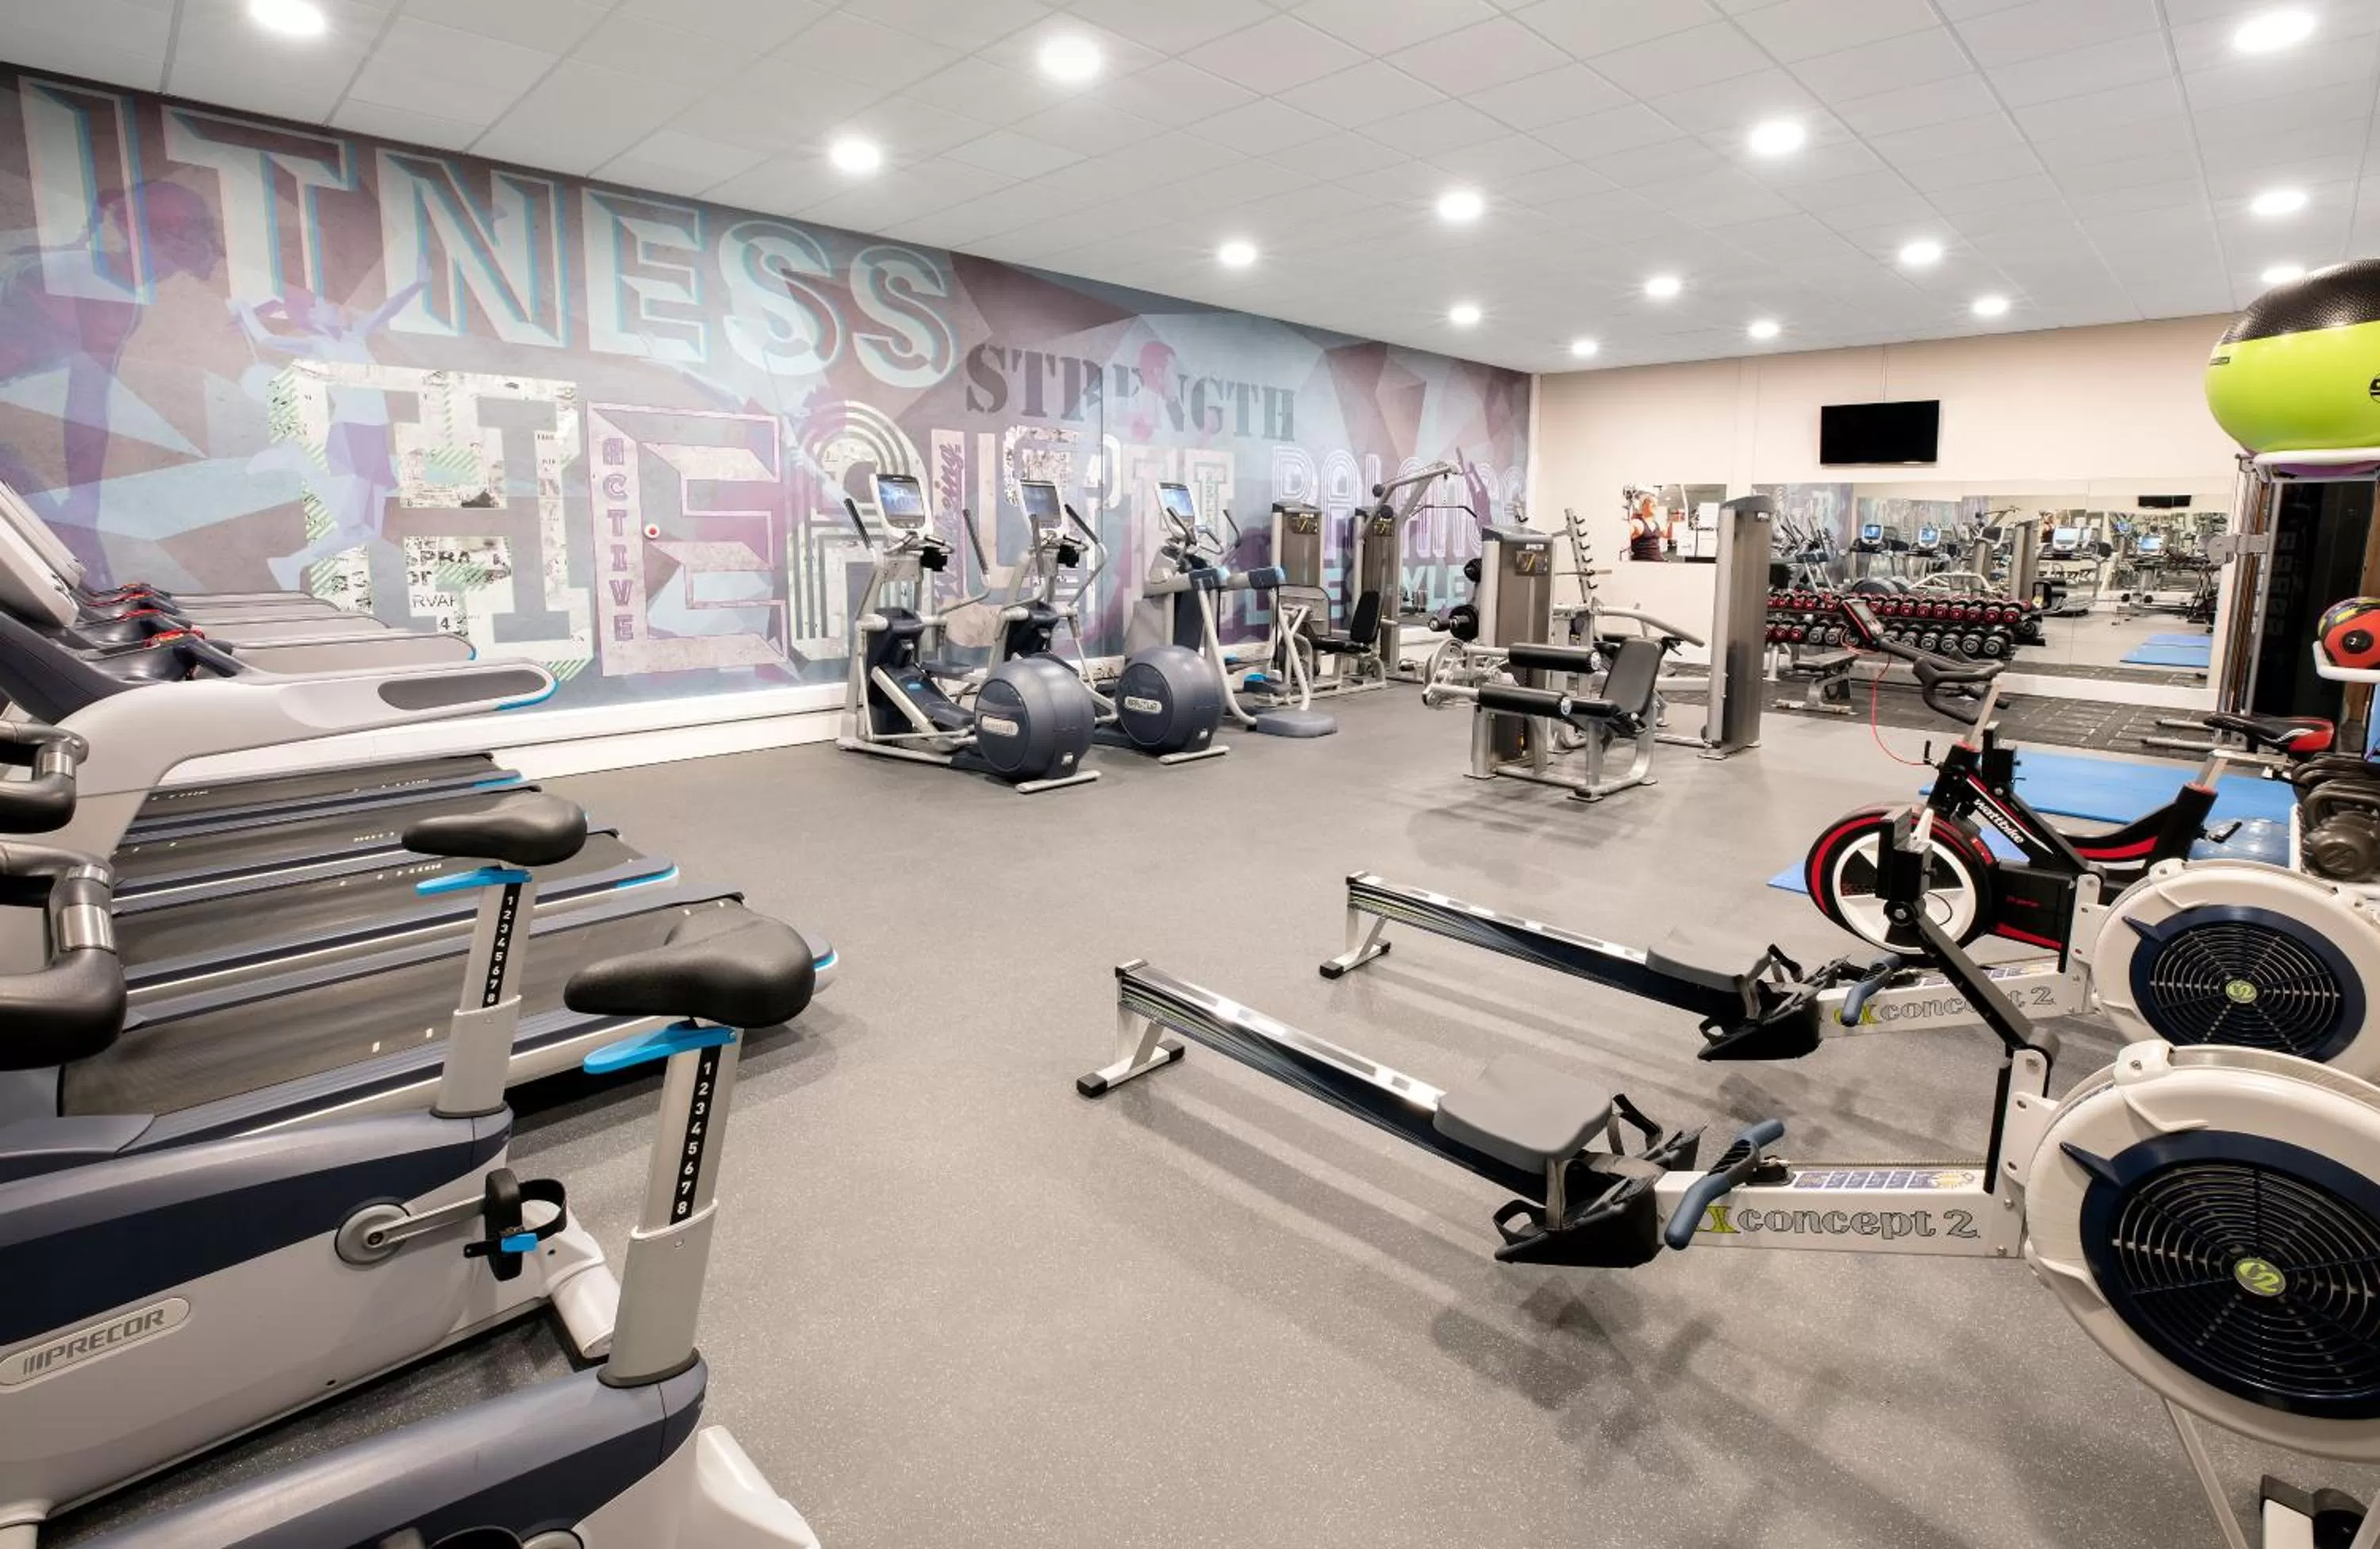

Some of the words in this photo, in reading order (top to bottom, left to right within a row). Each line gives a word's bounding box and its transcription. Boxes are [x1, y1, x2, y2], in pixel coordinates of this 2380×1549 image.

[1880, 990, 2025, 1020] conct
[1737, 1209, 1937, 1240] concept
[1944, 1209, 1979, 1238] 2
[44, 1309, 164, 1366] PRECOR
